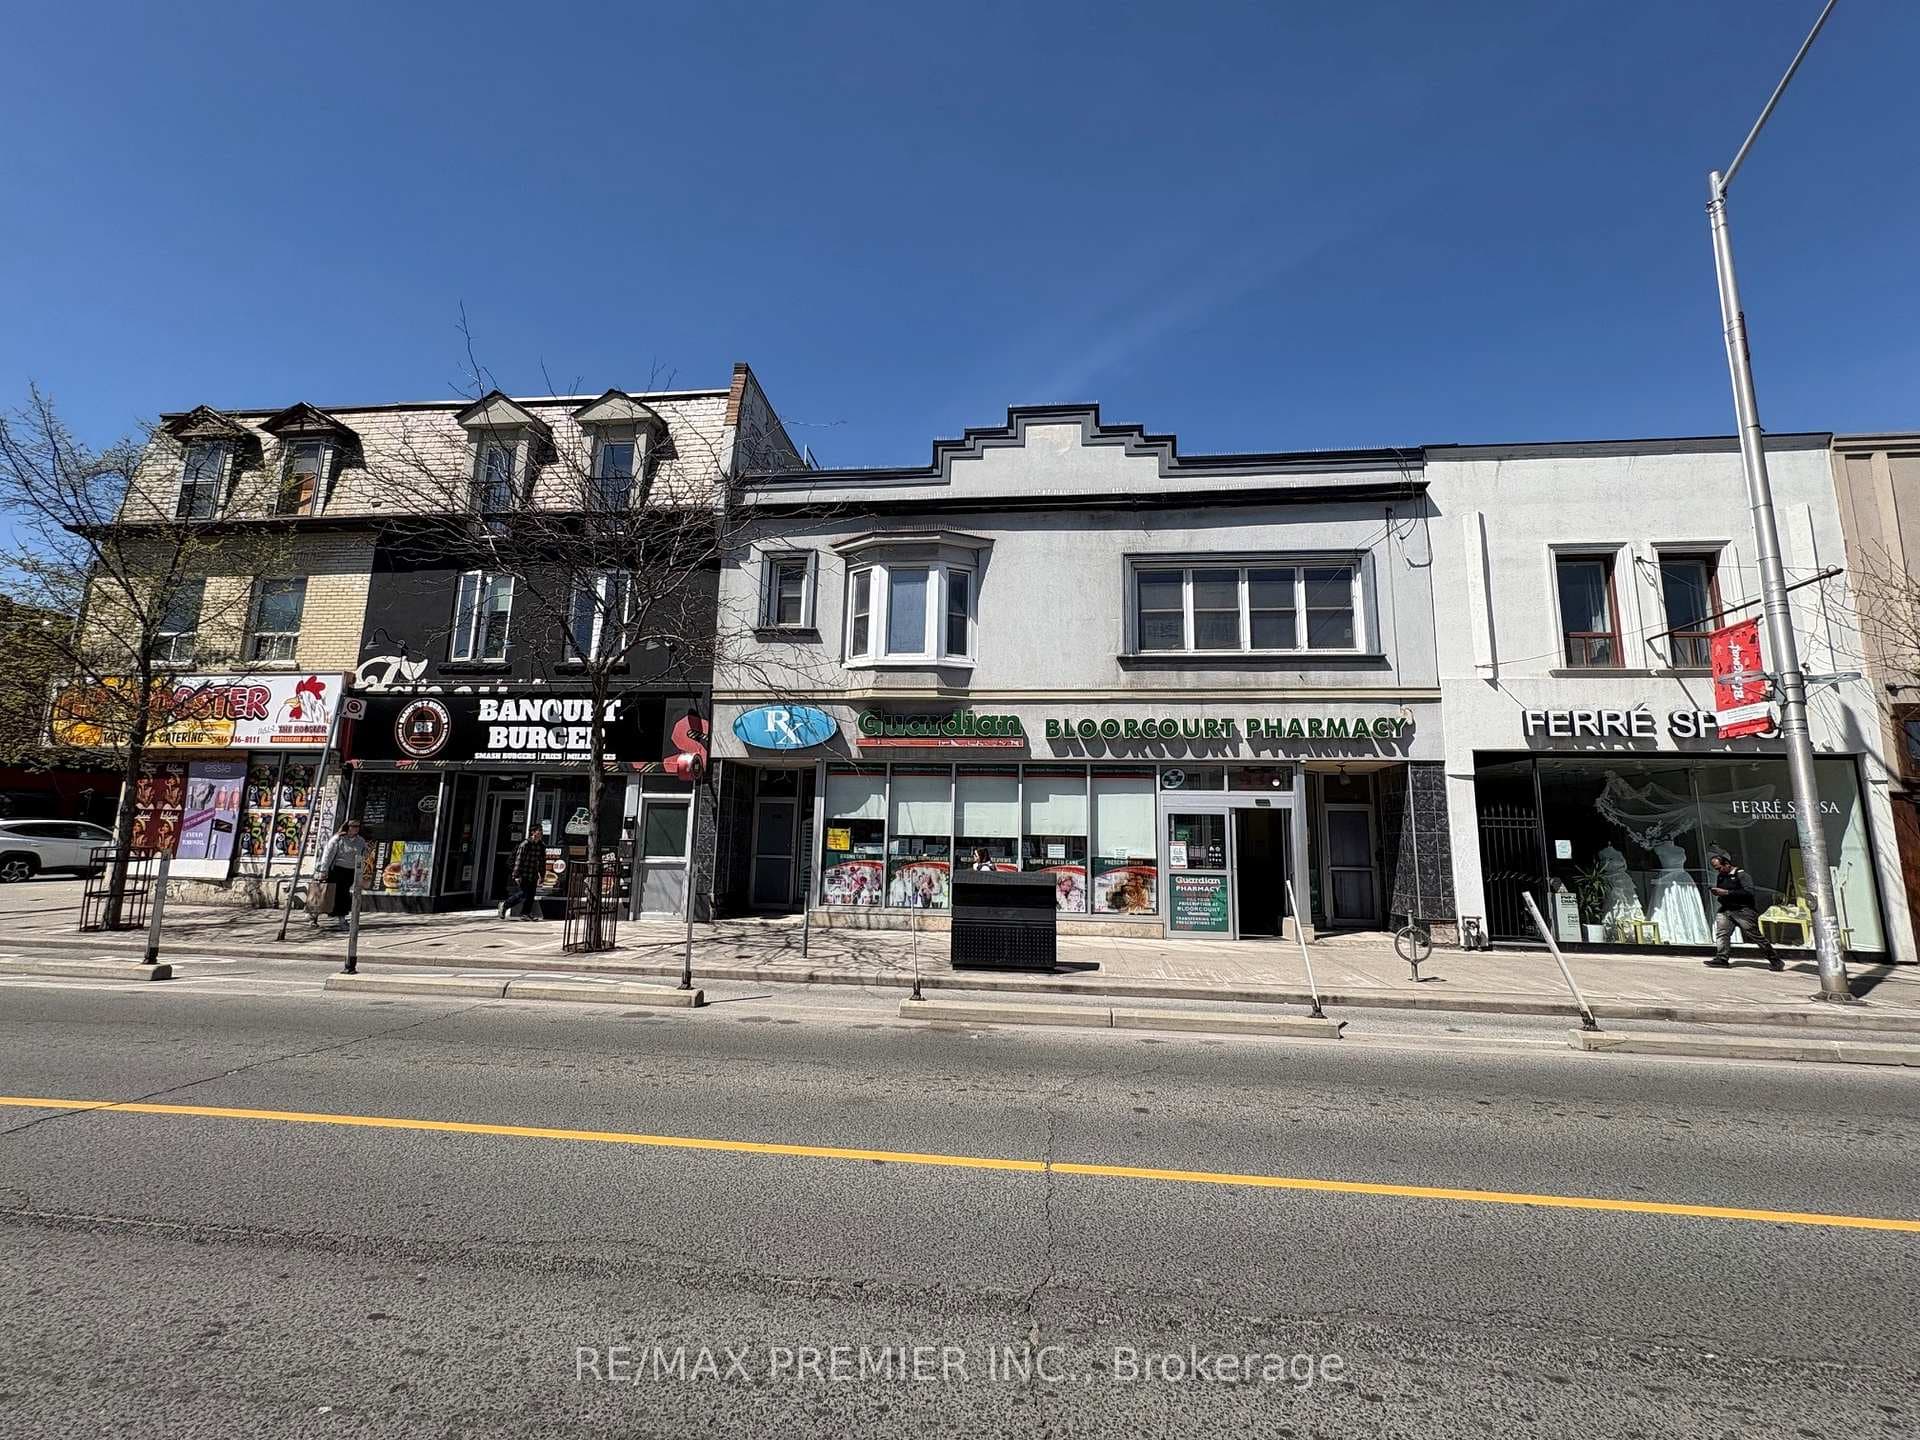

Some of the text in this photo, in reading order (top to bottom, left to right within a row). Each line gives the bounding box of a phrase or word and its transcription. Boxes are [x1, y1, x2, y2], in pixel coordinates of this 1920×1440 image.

[857, 709, 1023, 736] Guardian
[1045, 716, 1409, 739] BLOORCOURT PHARMACY
[1524, 703, 1655, 737] FERRÉ
[475, 752, 500, 760] SMASH
[502, 752, 536, 760] BURGERS
[541, 752, 562, 760] FRIES
[1732, 799, 1840, 814] FERRÉ SSA
[1175, 876, 1221, 885] Guardian
